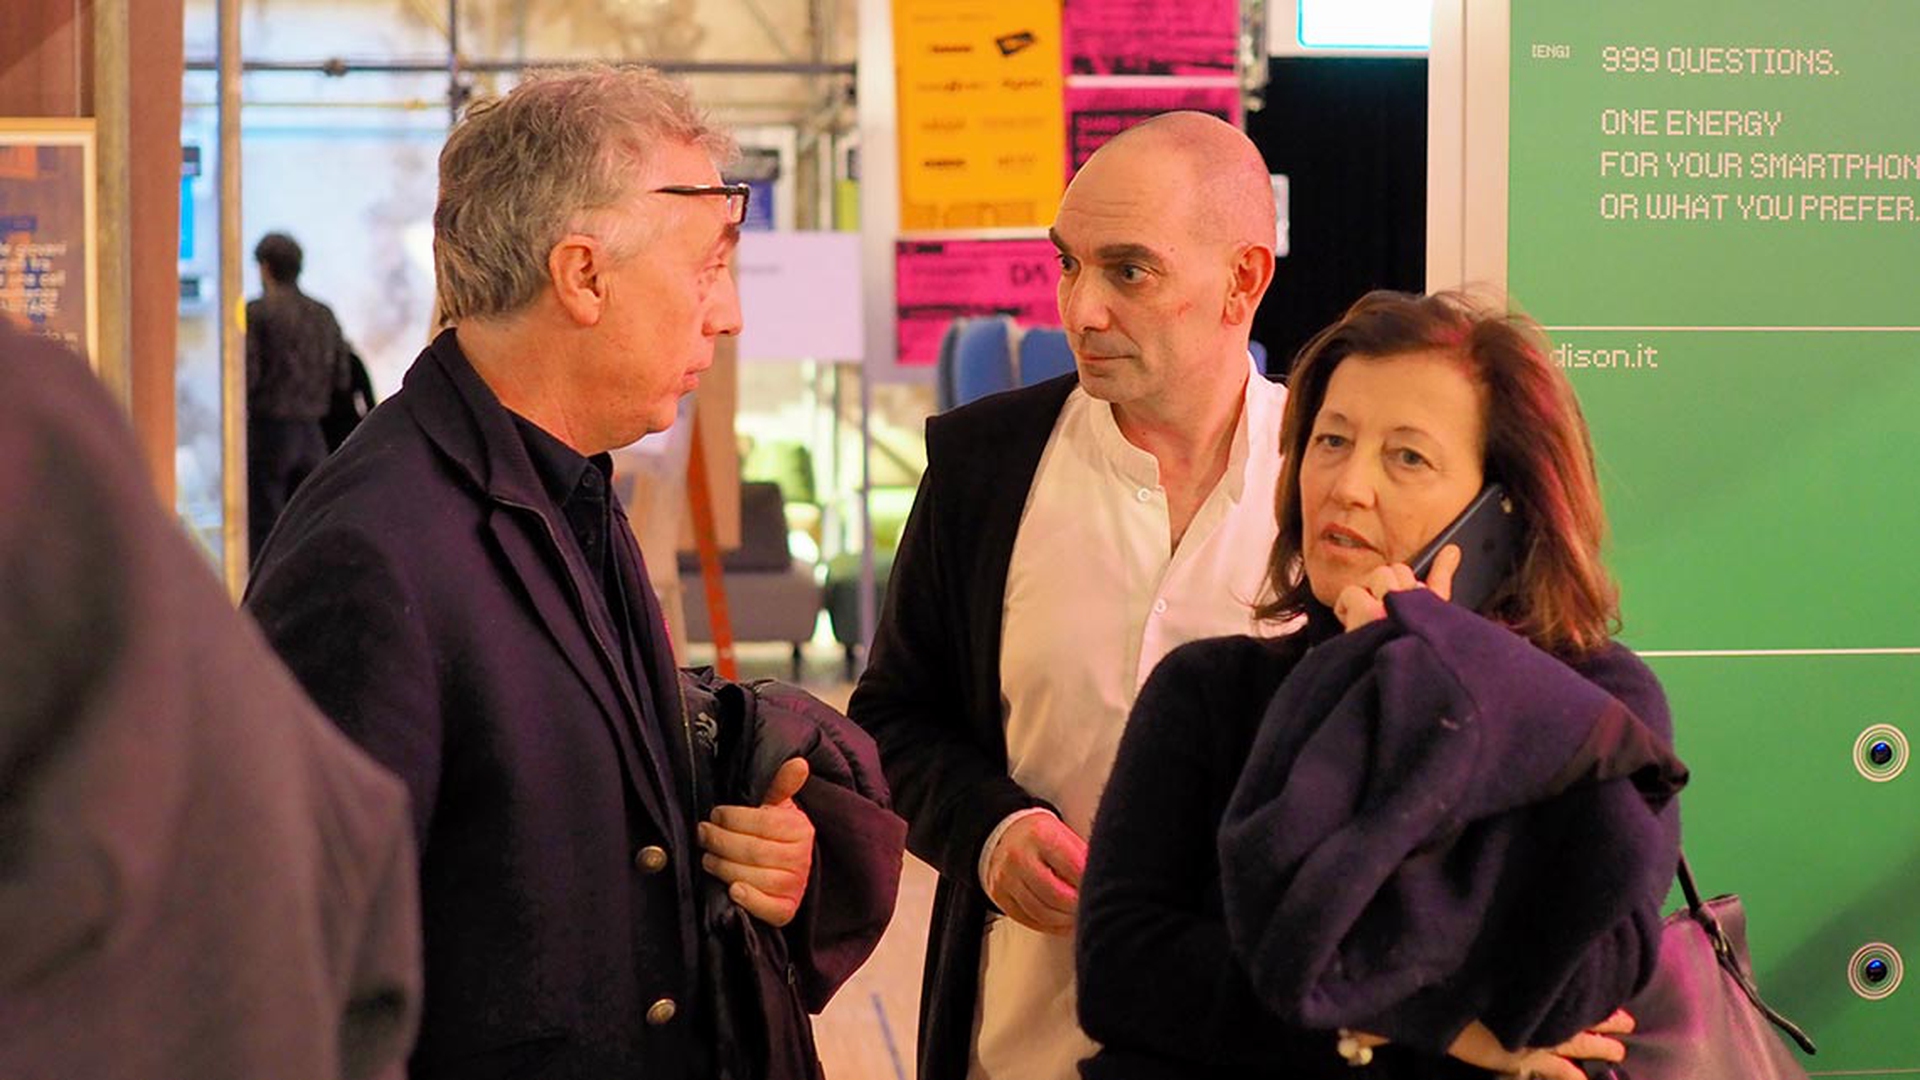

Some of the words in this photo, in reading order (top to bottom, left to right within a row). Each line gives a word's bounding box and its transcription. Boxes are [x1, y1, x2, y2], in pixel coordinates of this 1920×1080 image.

[1602, 46, 1660, 73] 999
[1667, 47, 1840, 76] QUESTIONS.
[1601, 109, 1659, 136] ONE
[1666, 109, 1782, 137] ENERGY
[1600, 151, 1659, 178] FOR
[1666, 151, 1743, 179] YOUR
[1750, 153, 1920, 180] SMARTPHON
[1600, 193, 1639, 220] OR
[1645, 193, 1730, 221] WHAT
[1736, 194, 1794, 221] YOU
[1800, 194, 1920, 222] PREFER.
[1549, 342, 1659, 369] dison.it
